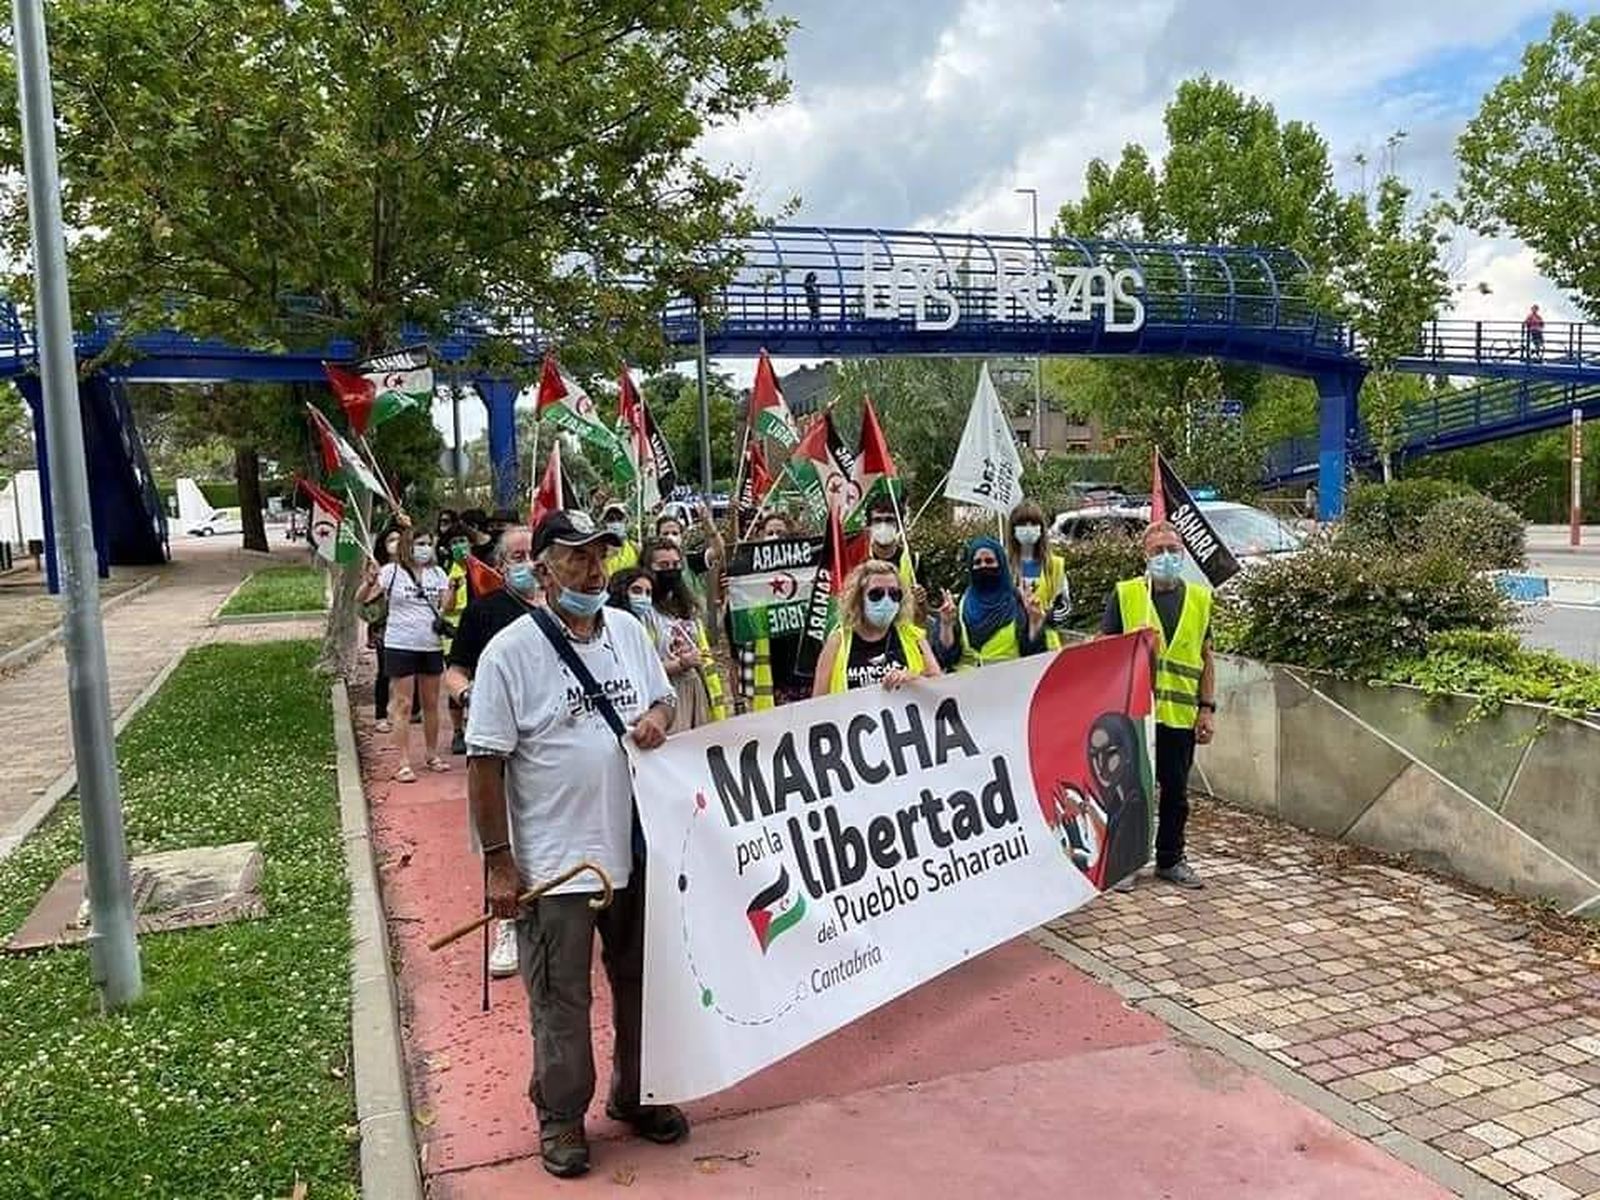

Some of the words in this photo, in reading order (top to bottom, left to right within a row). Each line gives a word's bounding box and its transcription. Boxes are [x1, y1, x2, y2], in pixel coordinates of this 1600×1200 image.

[863, 239, 961, 331] LAS
[995, 251, 1146, 333] ROZAS
[1170, 504, 1219, 563] SAHARA
[567, 679, 632, 701] MCHA
[706, 697, 980, 827] MARCHA
[736, 838, 766, 875] por
[762, 825, 783, 854] la
[787, 755, 1019, 899] libertad
[817, 918, 839, 944] del
[833, 869, 920, 932] Pueblo
[922, 827, 1030, 892] Saharaui
[811, 943, 883, 993] Cantabria
